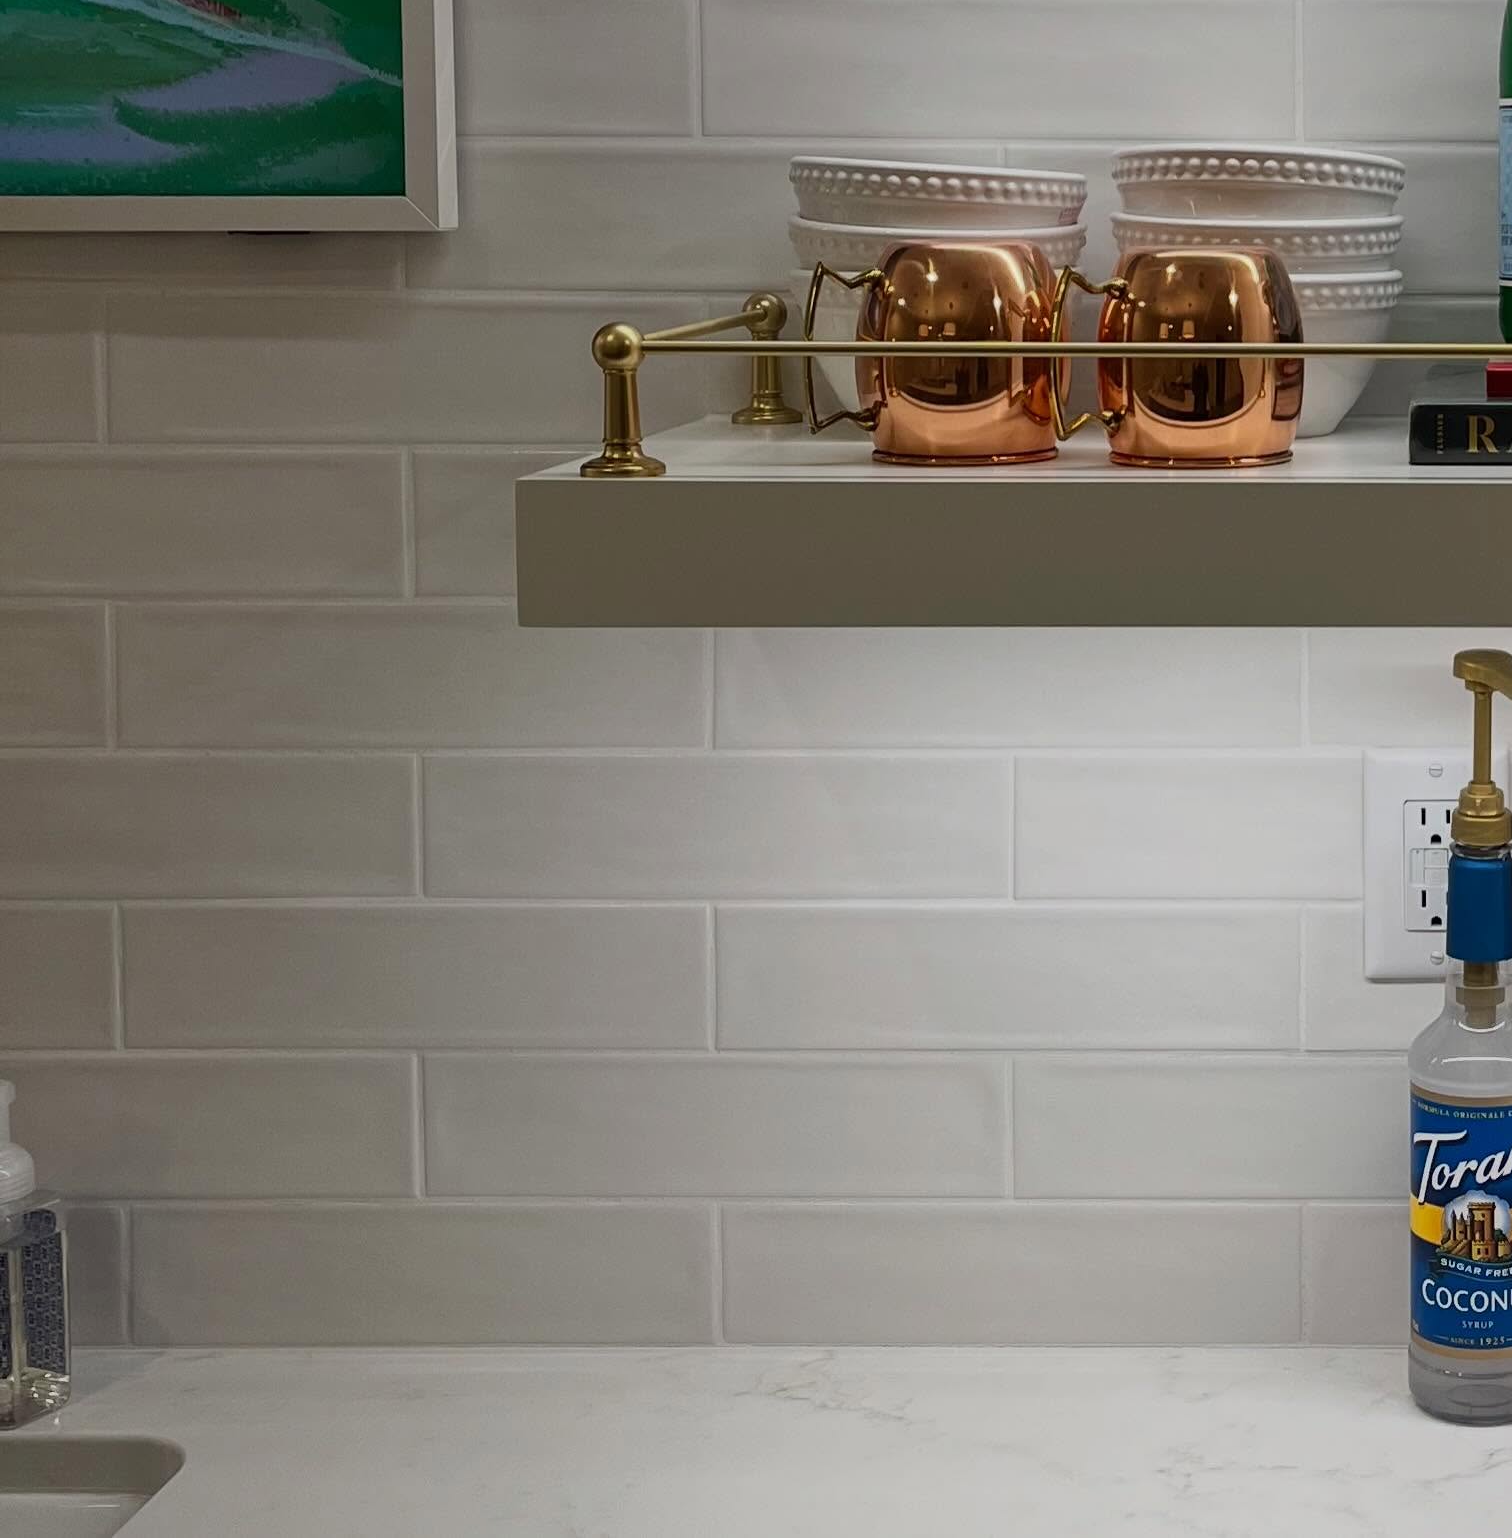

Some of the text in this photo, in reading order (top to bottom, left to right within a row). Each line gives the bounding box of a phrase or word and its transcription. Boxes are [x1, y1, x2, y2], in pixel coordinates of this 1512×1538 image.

[1453, 1110, 1505, 1119] ORIGINALE
[1440, 1257, 1481, 1275] SUGAR
[1462, 1320, 1494, 1329] SYRUP
[1480, 1335, 1505, 1346] 1925
